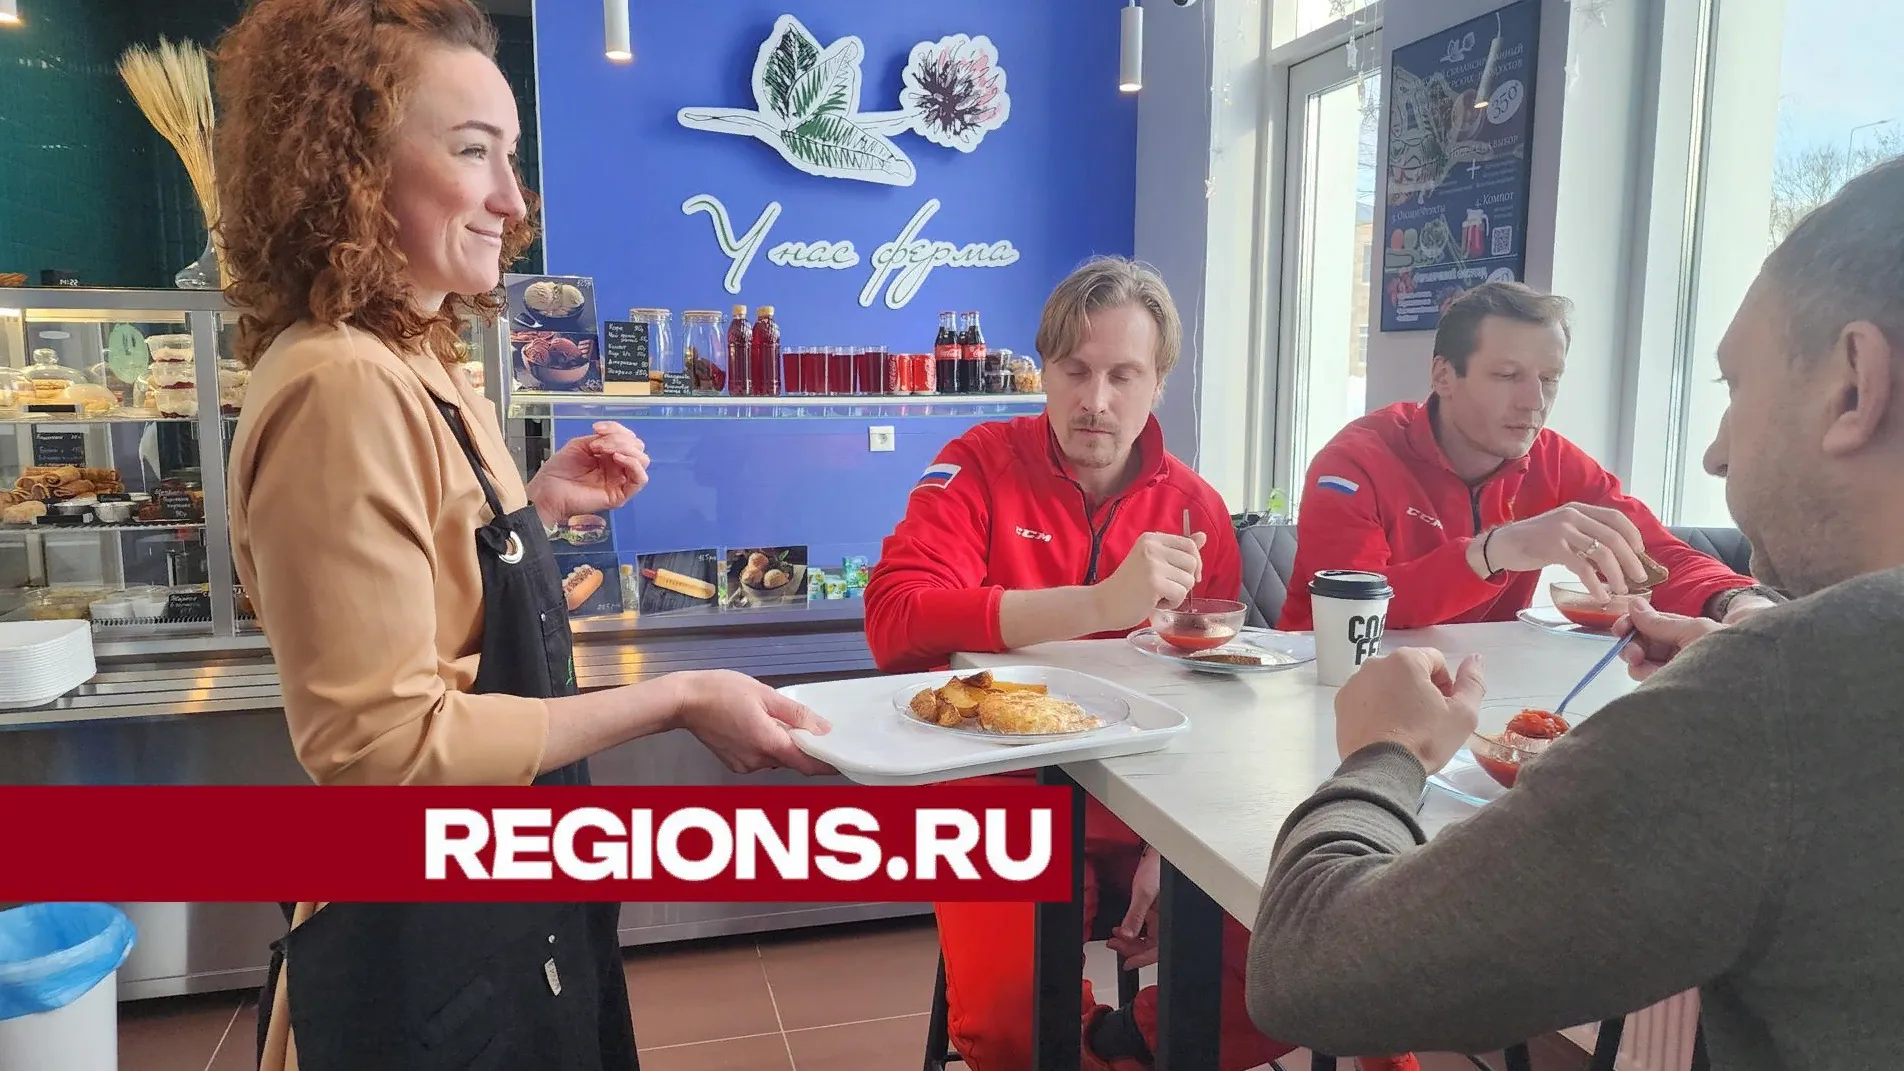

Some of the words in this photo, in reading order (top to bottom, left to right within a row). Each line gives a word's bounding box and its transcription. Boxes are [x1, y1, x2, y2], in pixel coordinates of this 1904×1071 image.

[1491, 85, 1518, 119] 350
[681, 194, 782, 295] У
[768, 240, 859, 270] нас
[858, 198, 1020, 309] ферма
[1406, 506, 1443, 529] CCM
[1016, 526, 1052, 542] CCM
